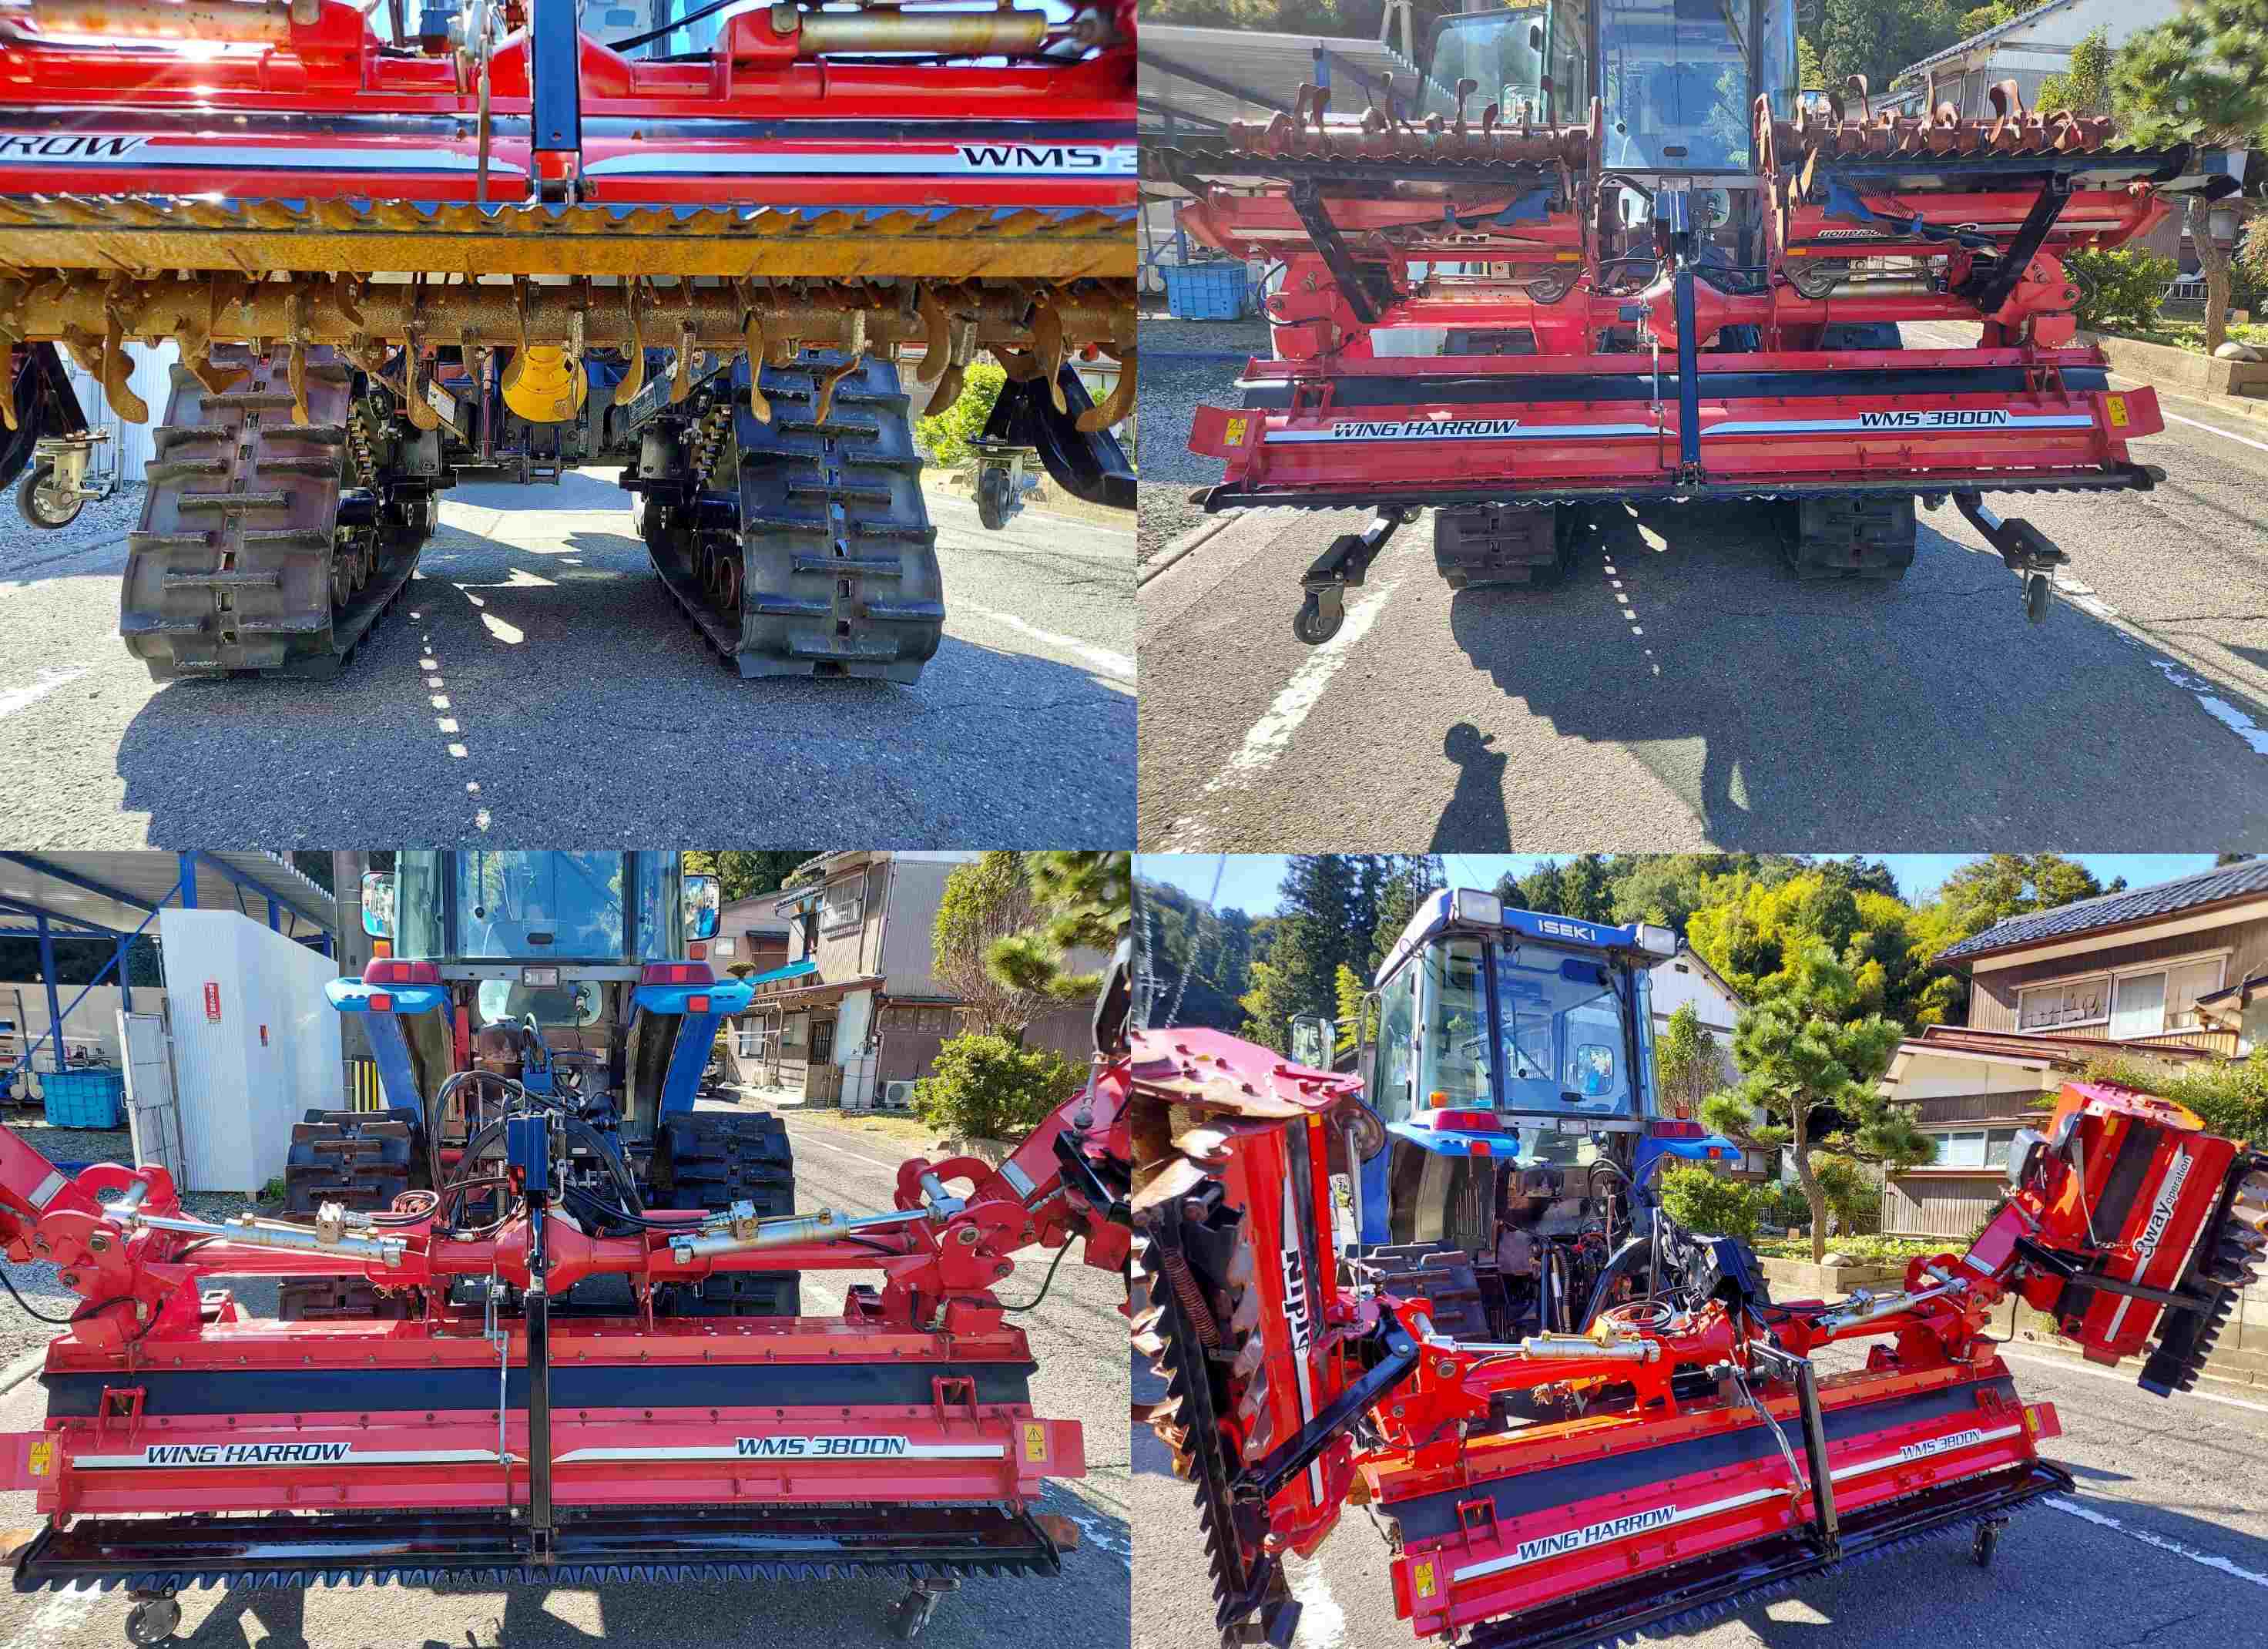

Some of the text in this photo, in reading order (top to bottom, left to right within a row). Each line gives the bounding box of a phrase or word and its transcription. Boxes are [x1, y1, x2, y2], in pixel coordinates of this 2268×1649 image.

[0, 136, 145, 155] ROW
[962, 147, 1102, 167] WMS
[1860, 410, 2008, 426] WMS 3800N
[1334, 420, 1516, 438] WING HARROW
[1538, 919, 1596, 941] ISEKI
[2135, 1157, 2192, 1258] 3way operation
[147, 1443, 348, 1463] WING HARROW
[737, 1438, 906, 1456] WMS 3800N
[1903, 1429, 1981, 1459] WMS 3800N
[1519, 1506, 1676, 1560] WING HARROW
